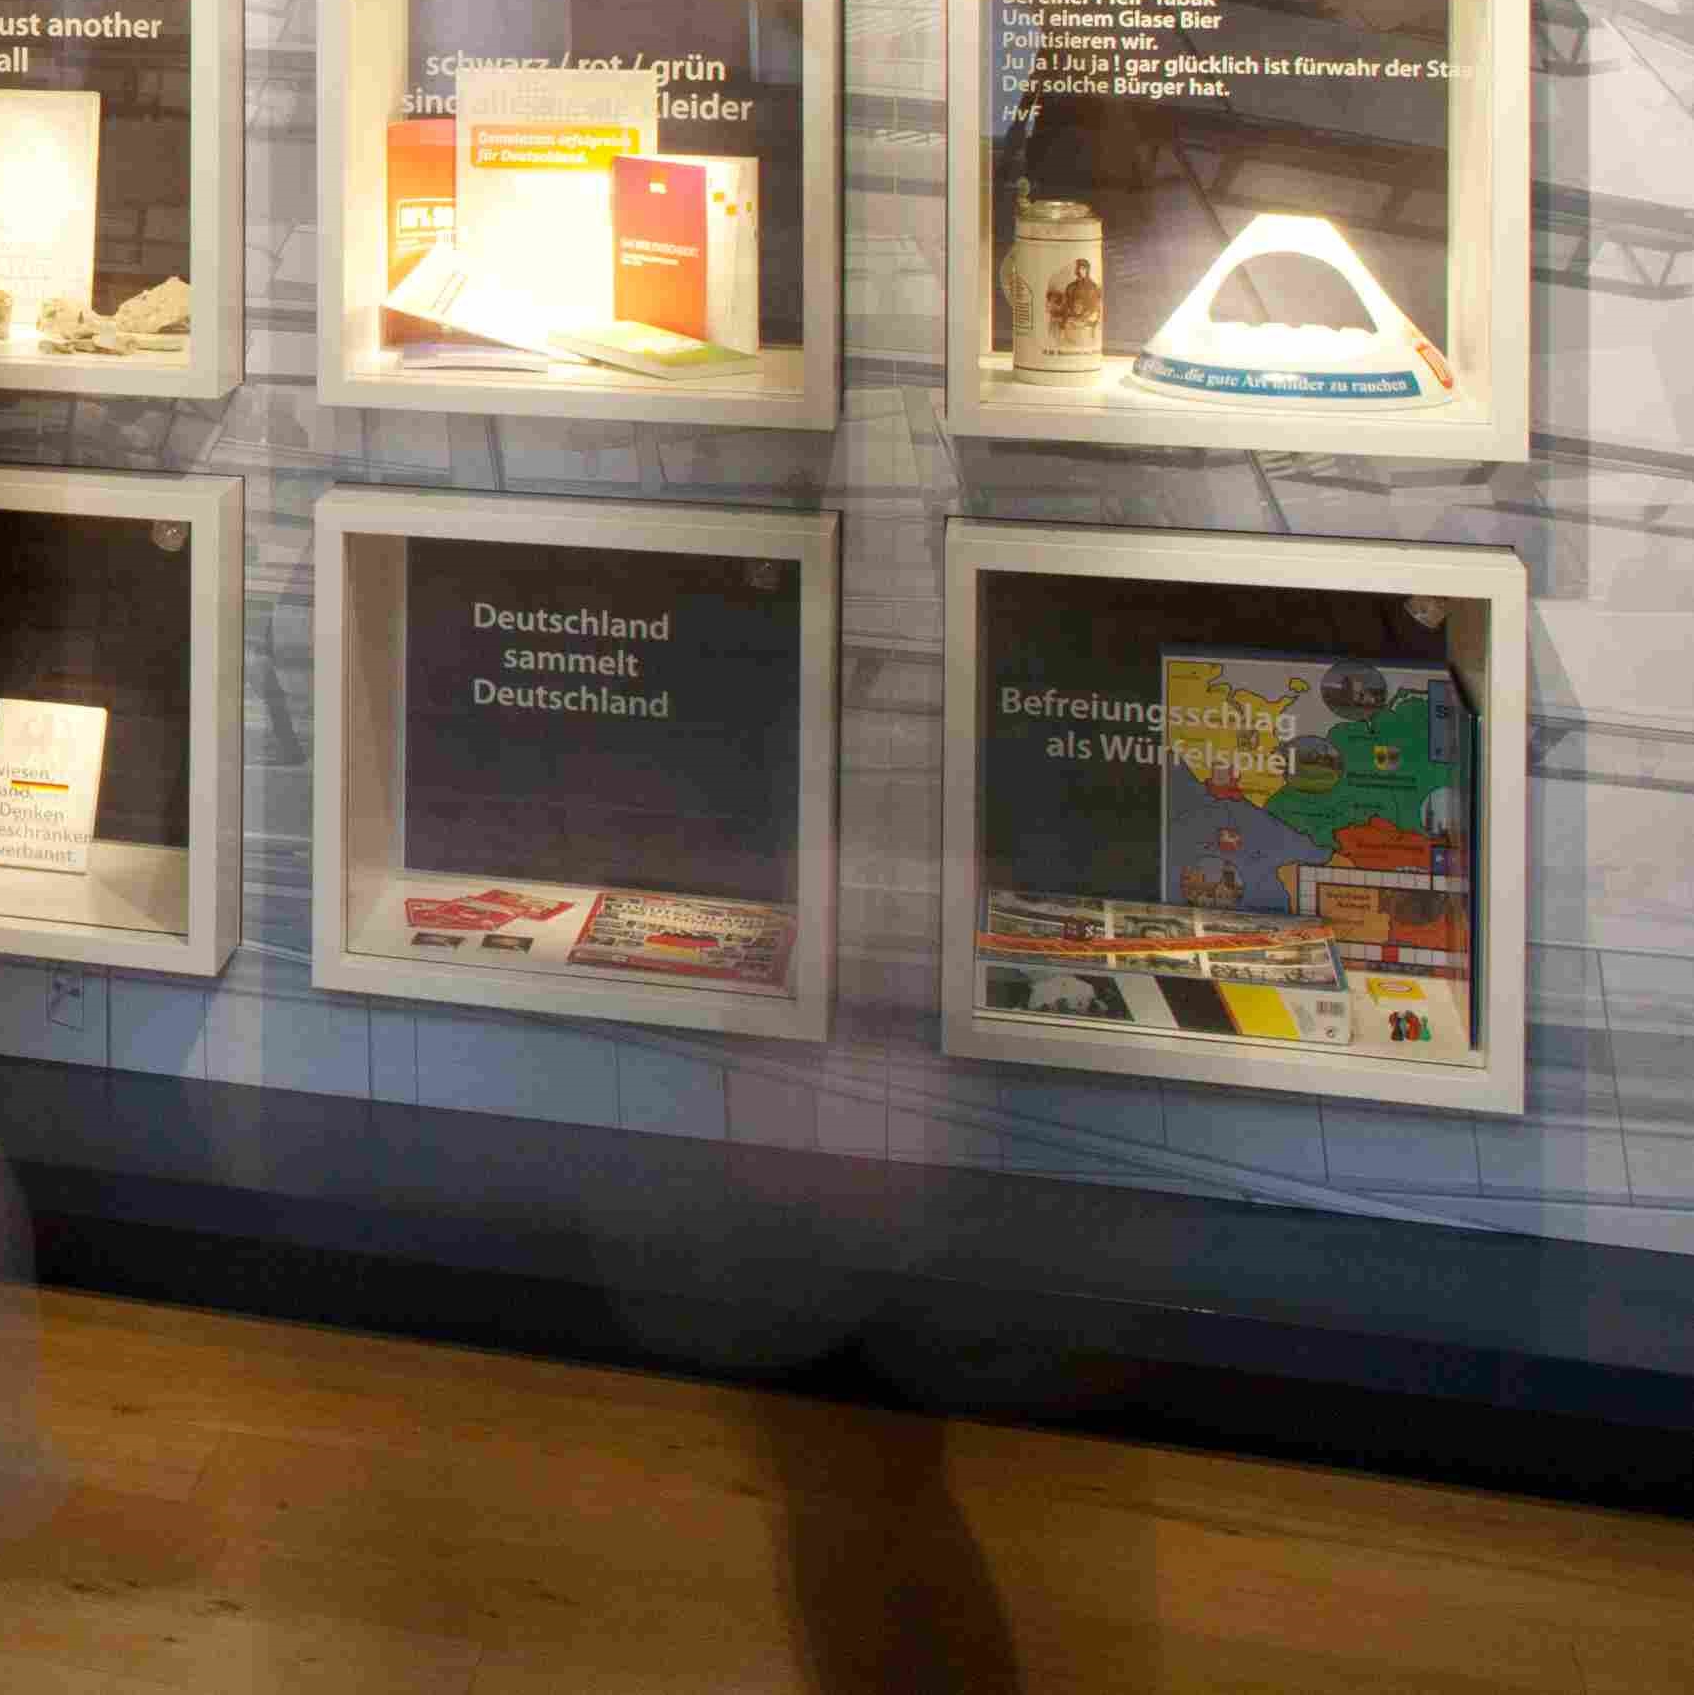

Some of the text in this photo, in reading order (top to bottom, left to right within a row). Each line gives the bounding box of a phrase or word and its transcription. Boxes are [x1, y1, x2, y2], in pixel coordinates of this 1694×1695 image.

[47, 10, 163, 40] another
[1002, 9, 1223, 29] Und einem Glase Bier
[1003, 31, 1159, 50] Politisieren wir.
[653, 52, 727, 85] grün
[1028, 53, 1048, 75] ja
[1062, 54, 1086, 72] Ju
[1088, 54, 1110, 76] ja
[1125, 57, 1161, 77] gar
[1164, 54, 1258, 77] glücklich
[1264, 56, 1291, 76] ist
[1294, 56, 1381, 78] fürwahr
[1384, 58, 1423, 78] der
[1002, 74, 1232, 98] Der solche Bürger hat.
[1001, 105, 1042, 123] HvF
[473, 602, 669, 641] Deutschland
[503, 648, 639, 677] sammelt
[473, 677, 669, 717] Deutschland
[1001, 686, 1298, 741] Befreiungsschlag
[1045, 730, 1297, 775] als Würfelspiel
